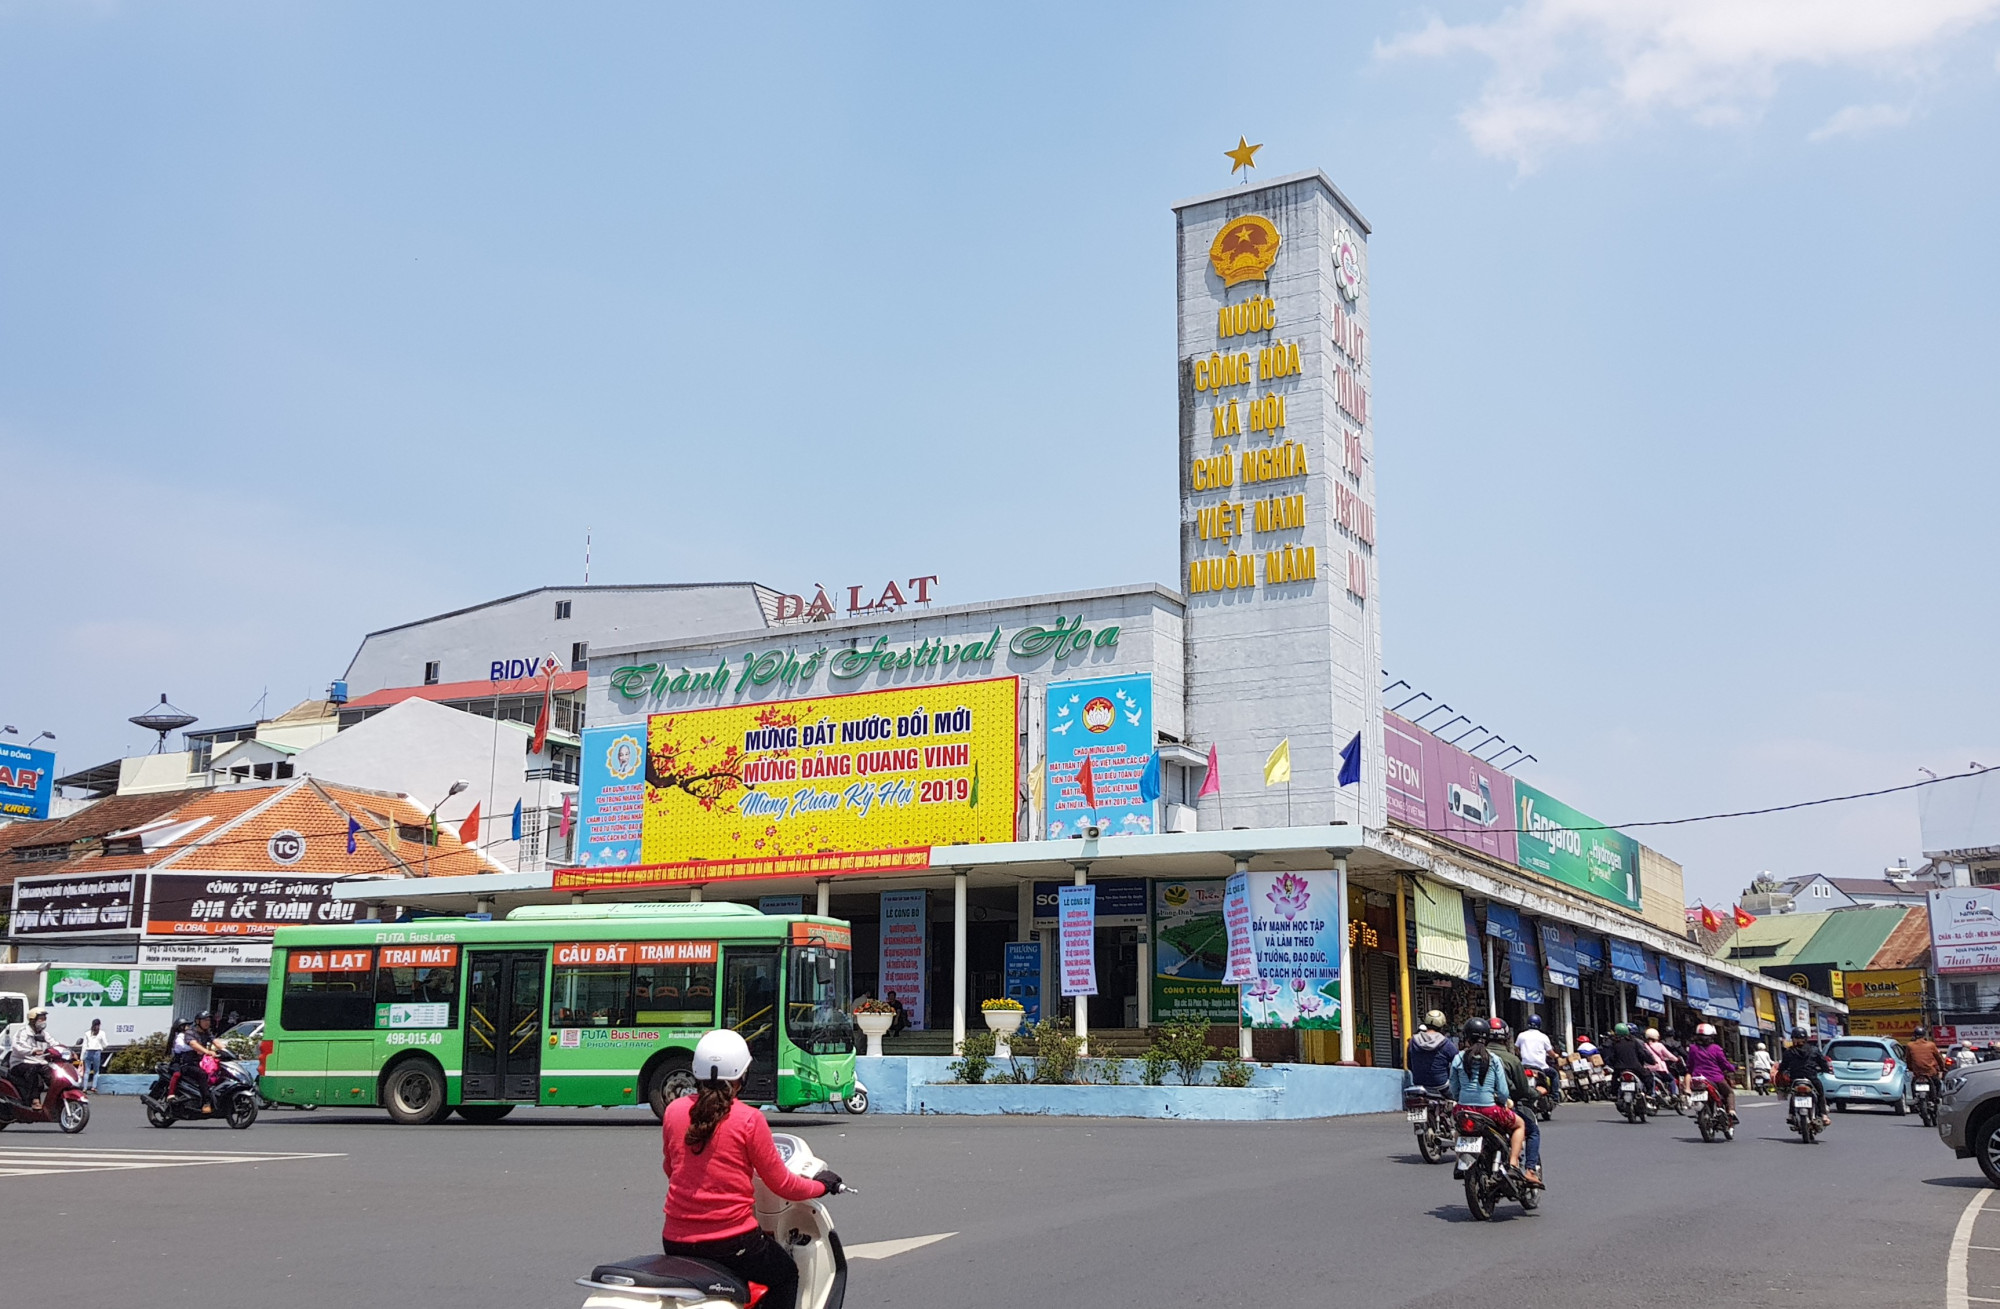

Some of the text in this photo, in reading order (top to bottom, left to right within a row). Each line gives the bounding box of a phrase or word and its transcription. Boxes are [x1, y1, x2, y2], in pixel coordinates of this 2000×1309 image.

[1219, 295, 1275, 338] NƯỚC
[1194, 338, 1302, 392] CỘNG HÒA
[1334, 362, 1366, 426] THÀNH
[1213, 391, 1286, 439] XÃ HỘI
[1343, 428, 1363, 478] PHỐ
[1193, 437, 1308, 491] CHỦ NGHĨA
[1197, 494, 1306, 544] VIỆT NAM
[1332, 478, 1375, 547] FESTIVAL
[1190, 543, 1316, 593] MUÔN NĂM
[1346, 549, 1367, 600] HOA
[847, 575, 938, 612] LẠT
[611, 614, 1119, 700] Thành Phố Festival Hoa
[490, 656, 539, 681] BIDV
[745, 706, 971, 752] MỪNG ĐẤT NƯỚC ĐỔI MỚI
[1073, 746, 1088, 756] CHÀO
[1089, 745, 1106, 754] MỪNG
[743, 744, 969, 783] MỪNG ĐẢNG QUANG VINH
[1100, 758, 1111, 767] VIỆT
[1112, 757, 1125, 765] NAM
[1127, 755, 1138, 763] CÁC
[1118, 768, 1133, 777] TOÀN
[1111, 784, 1124, 793] VIỆT
[739, 779, 968, 820] Mừng Xuân Kỷ Hợi 2019
[1113, 796, 1126, 805] 2019
[591, 825, 603, 833] THEO
[1521, 795, 1580, 857] Kangaroo
[590, 834, 607, 843] PHONG
[607, 833, 620, 842] CÁCH
[276, 840, 298, 855] TC
[206, 880, 239, 894] CÔNG
[260, 879, 283, 895] BẤT
[285, 881, 318, 897] ĐỘNG
[191, 900, 225, 922] ĐỊA
[230, 895, 257, 920] ỐC
[265, 898, 312, 920] TOÀN
[174, 924, 239, 933] GLOBAL LAND
[1253, 917, 1325, 935] ĐẨY MẠNH HỌC TẬP
[375, 932, 455, 943] FUTA Bus Lines
[1265, 934, 1315, 946] VÀ LÀM THEO
[299, 952, 366, 971] ĐÀ LẠT
[385, 947, 450, 965] TRẠI MÁT
[559, 943, 627, 962] CẦU ĐẤT
[640, 944, 712, 961] TRẠM HÀNH
[1293, 952, 1308, 966] ĐẠO
[144, 973, 171, 985] TATANA
[1269, 965, 1290, 978] CÁCH
[1291, 963, 1302, 978] HỒ
[1304, 965, 1317, 978] CHÍ
[1319, 968, 1339, 978] MINH
[1163, 986, 1185, 994] CÔNG
[1197, 985, 1207, 994] CỔ
[1209, 985, 1230, 993] PHẦN
[1864, 982, 1899, 991] Kodak
[386, 1032, 442, 1045] 49B-015.40
[581, 1030, 607, 1039] FUTA
[611, 1029, 630, 1039] Bus
[632, 1029, 659, 1039] Lines
